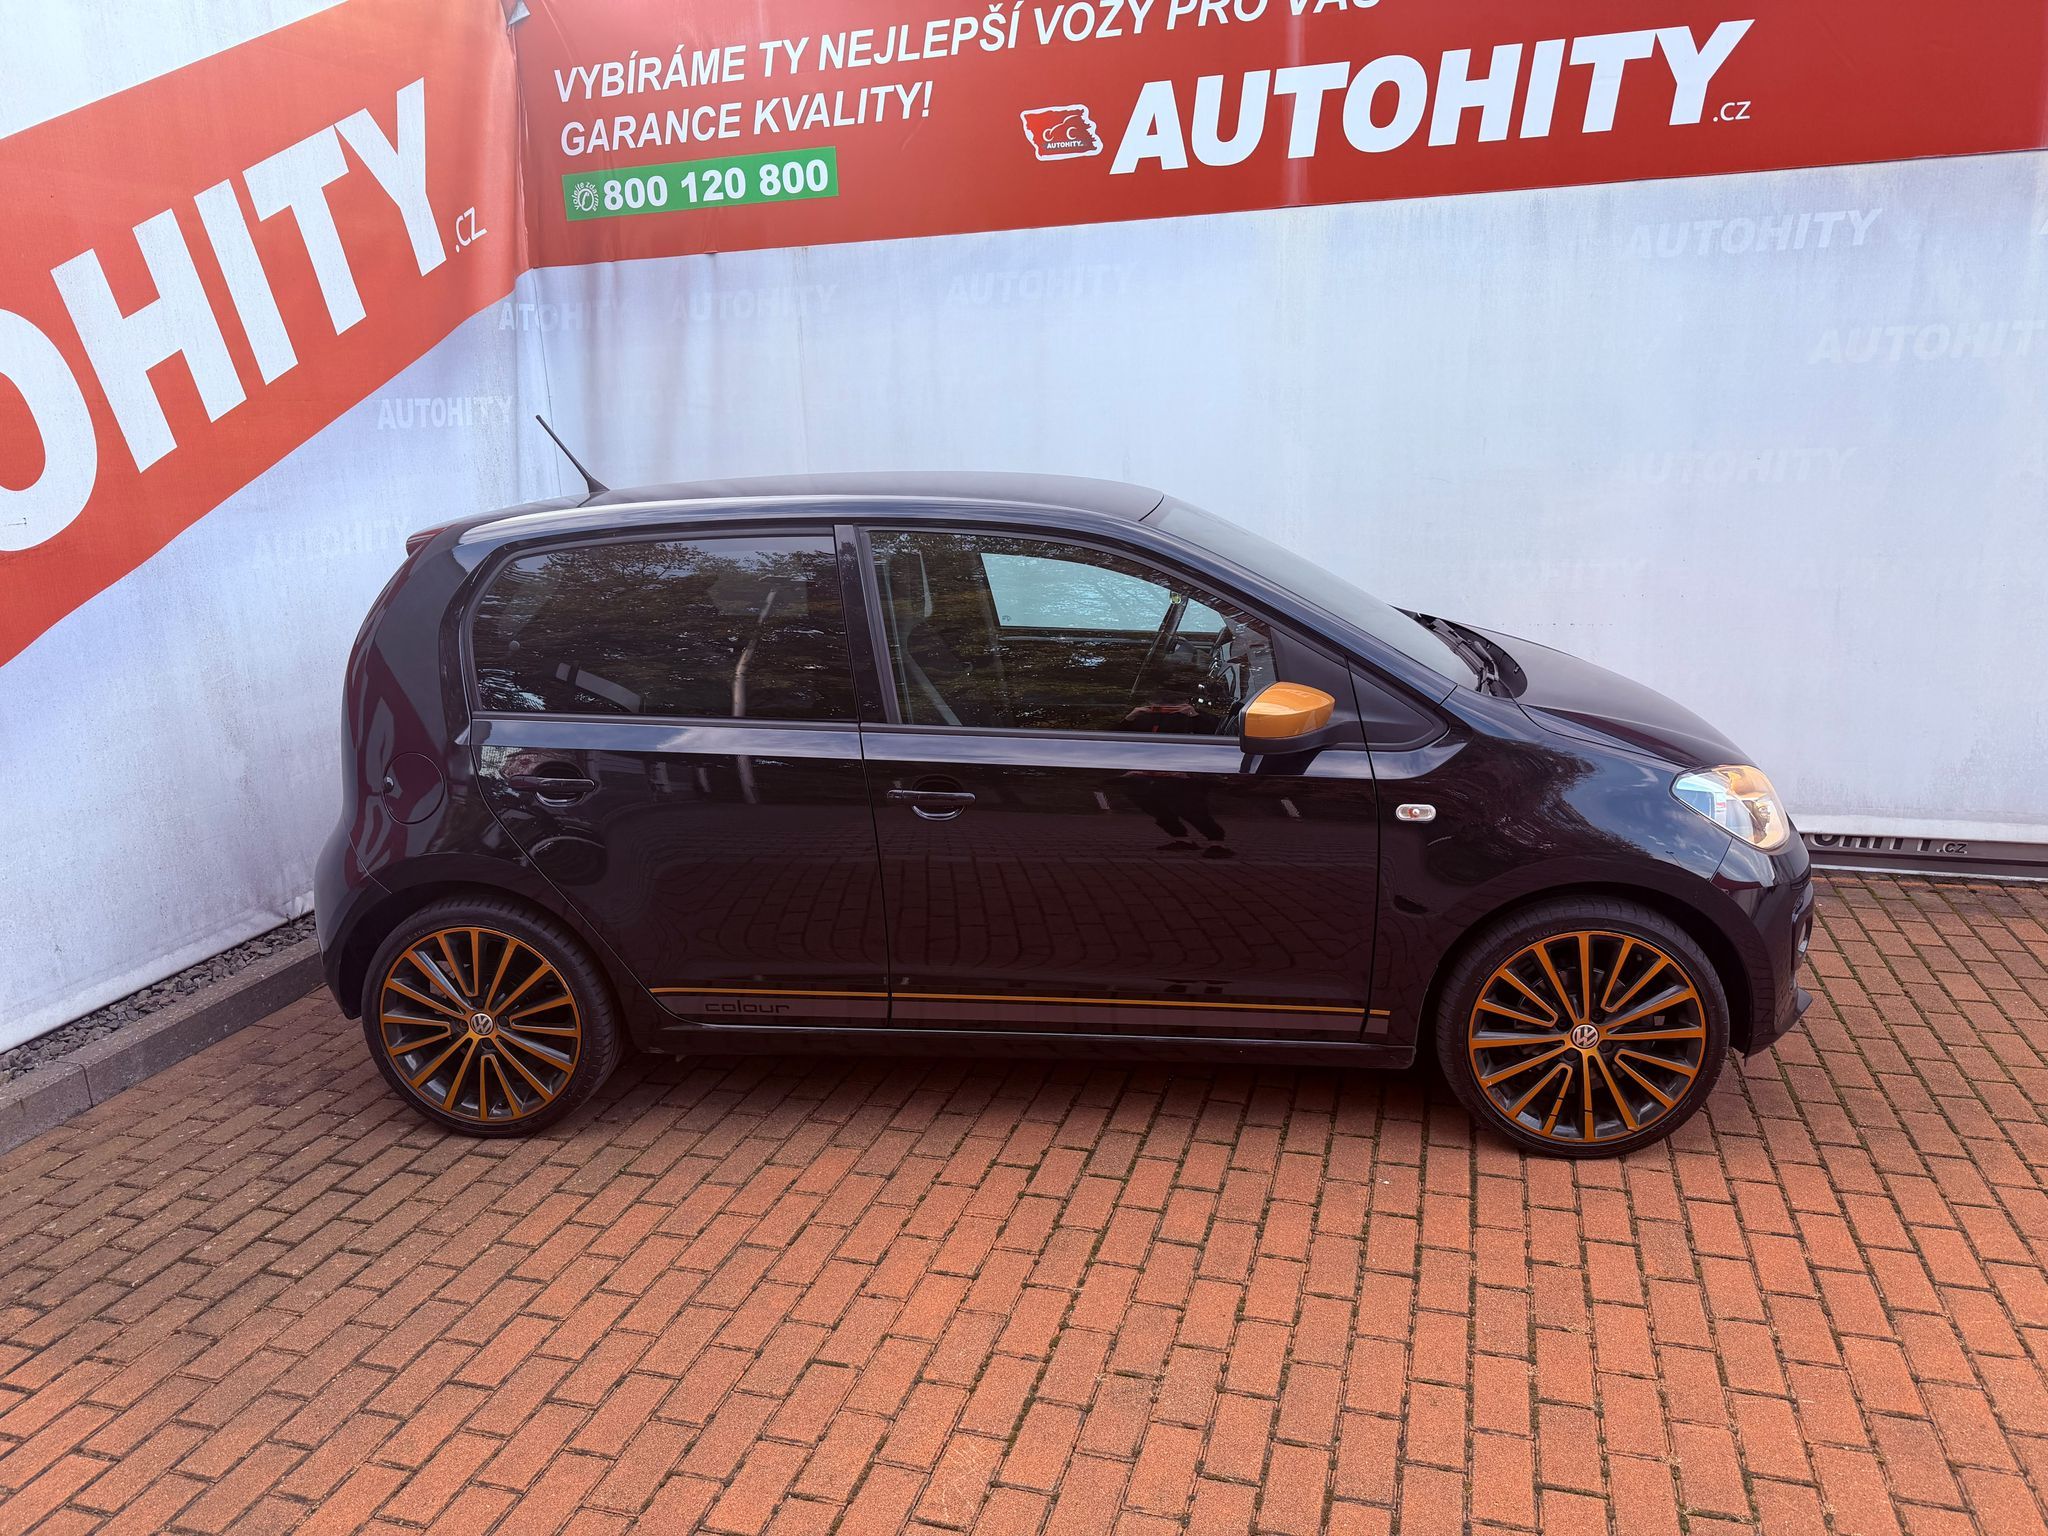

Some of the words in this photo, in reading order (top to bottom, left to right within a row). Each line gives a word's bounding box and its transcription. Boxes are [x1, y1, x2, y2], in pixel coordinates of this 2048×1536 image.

[554, 44, 747, 103] VYBÍRÁME
[759, 37, 809, 78] TY
[818, 0, 1024, 71] NEJLEPŠÍ
[1033, 0, 1155, 46] VOZY
[561, 102, 742, 156] GARANCE
[753, 80, 934, 136] KVALITY!
[603, 175, 668, 211] 800
[680, 166, 746, 204] 120
[759, 159, 829, 196] 800
[705, 1000, 790, 1014] colour
